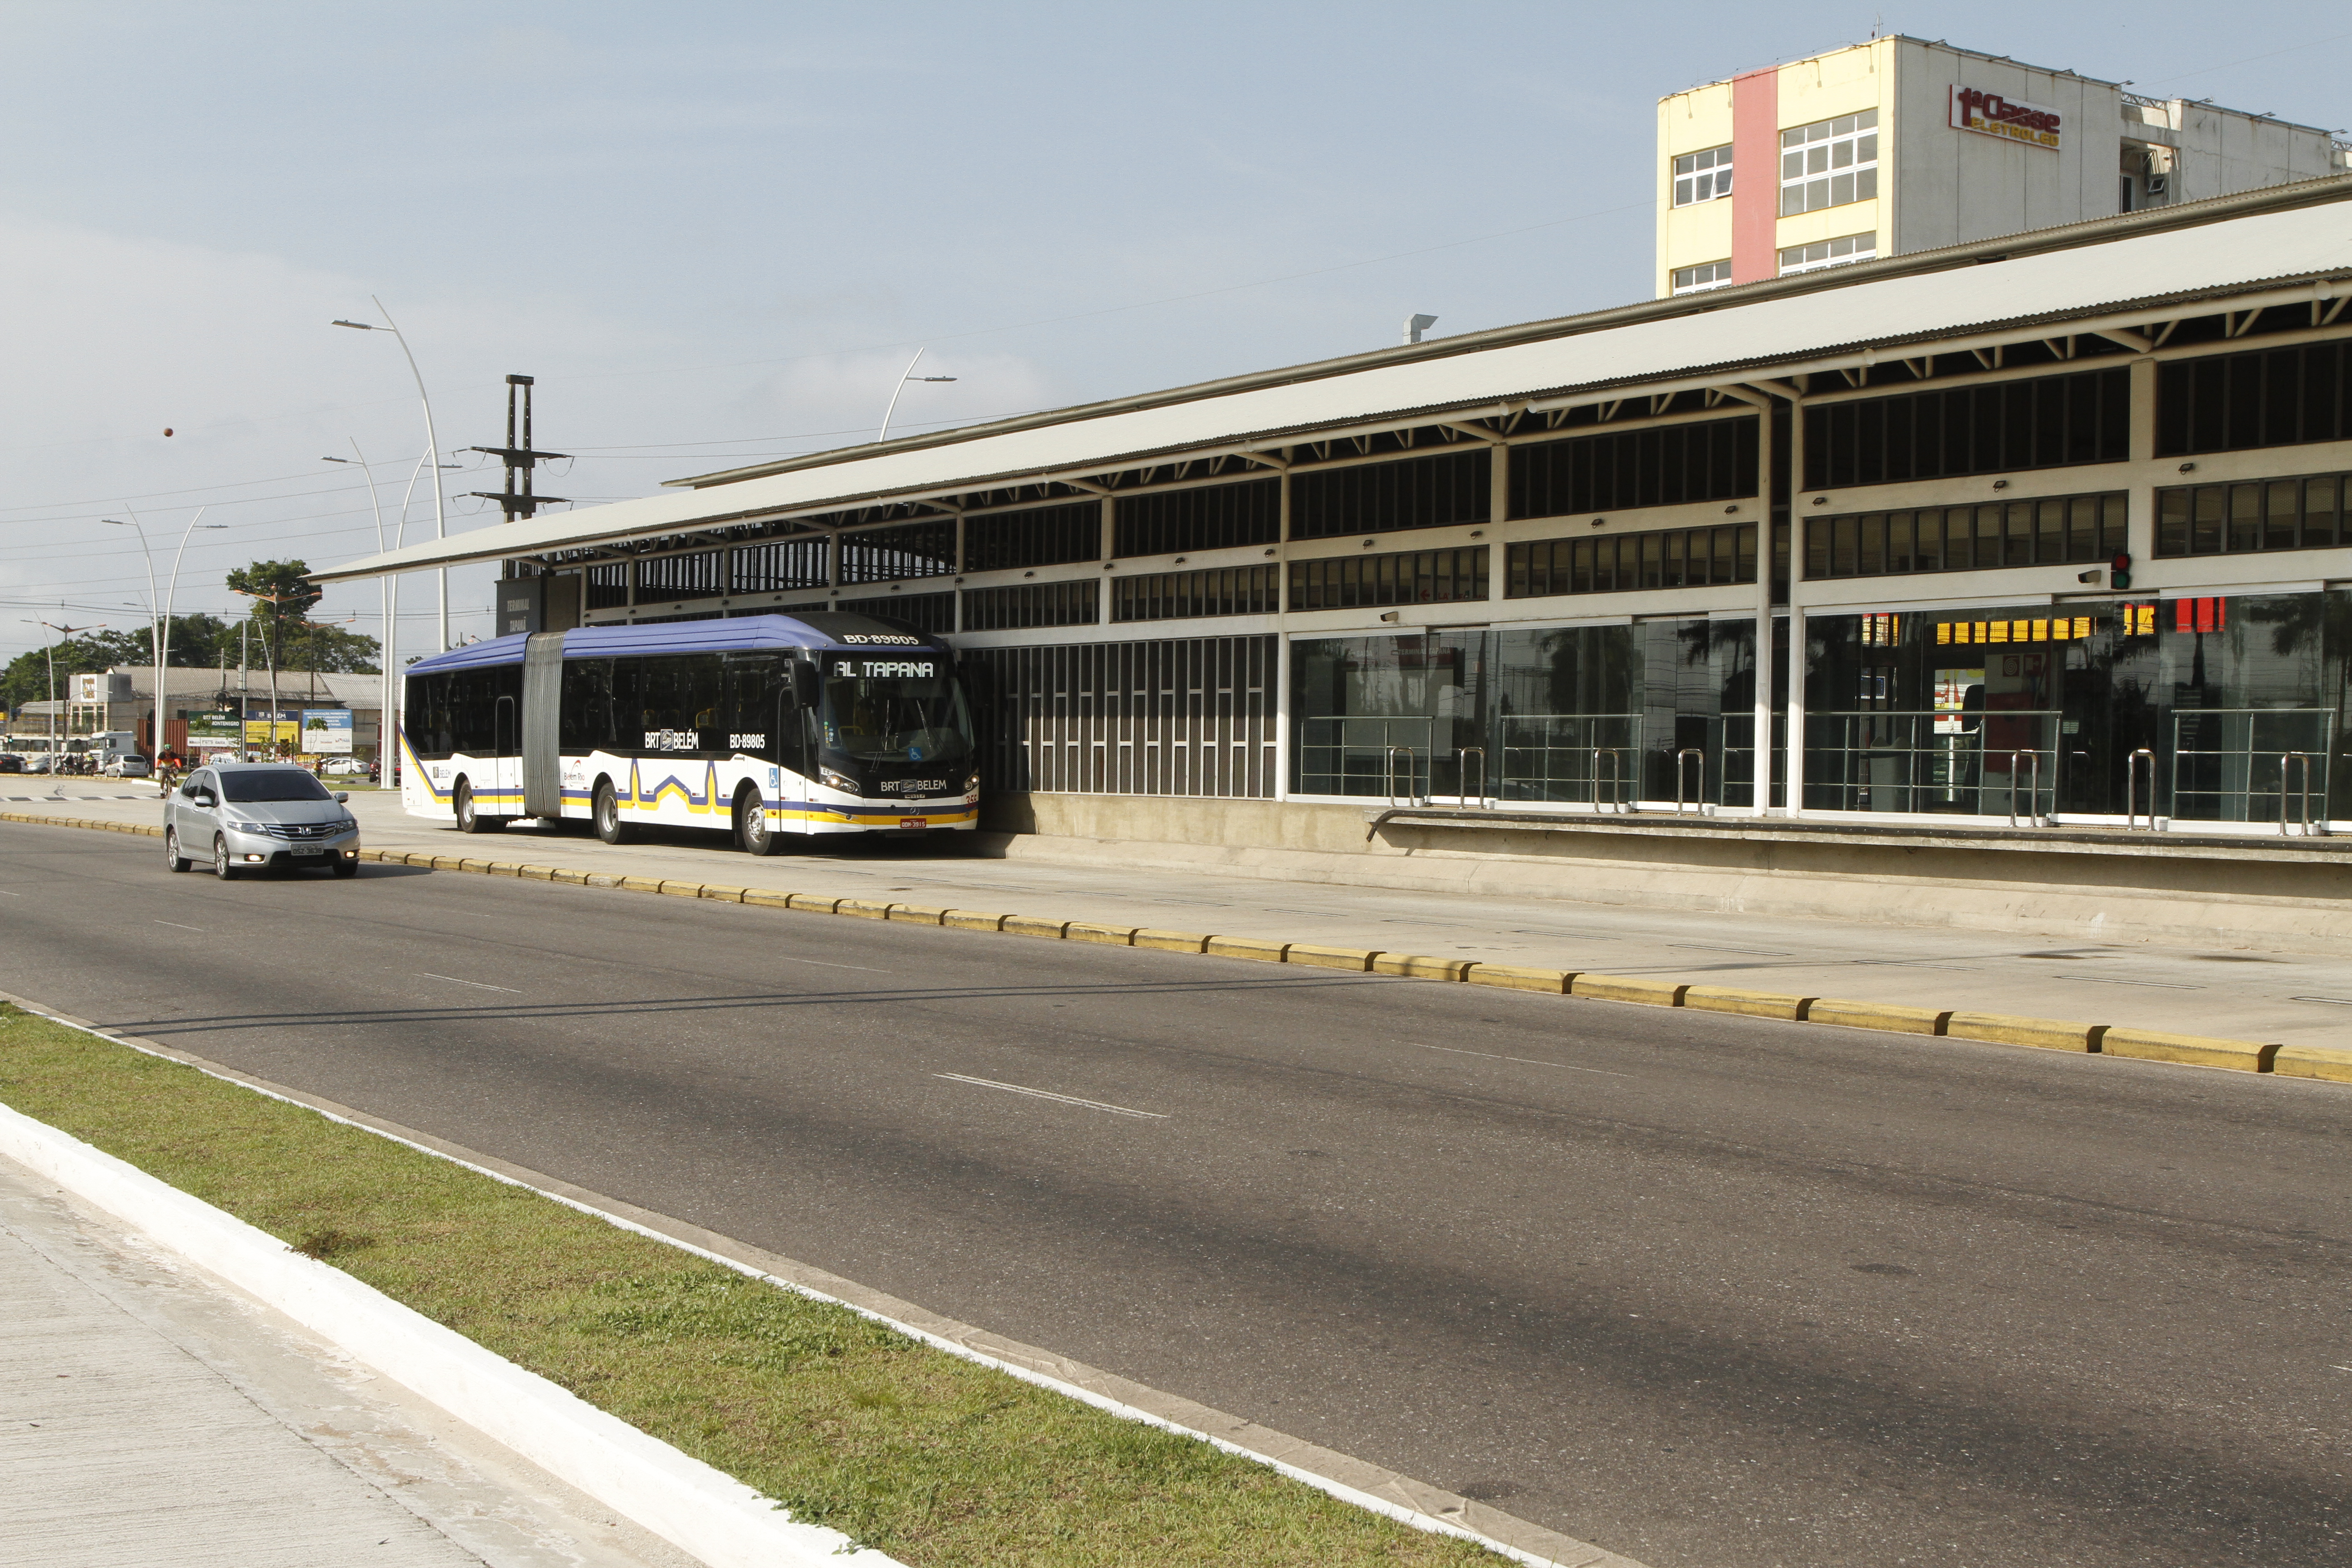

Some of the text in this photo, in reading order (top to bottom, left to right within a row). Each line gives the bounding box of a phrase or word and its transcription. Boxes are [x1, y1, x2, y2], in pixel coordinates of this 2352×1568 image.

[1983, 93, 2060, 134] Classe
[1970, 117, 2059, 146] ELETROLED
[507, 598, 529, 612] TERMINAL
[843, 635, 919, 645] BD-89805
[862, 662, 933, 677] TAPANA
[645, 728, 699, 749] BRT BELÉM
[730, 734, 765, 749] BD-89805
[440, 769, 451, 778] BELÉM
[564, 772, 577, 780] Belém
[881, 780, 947, 791] BRT BELEM
